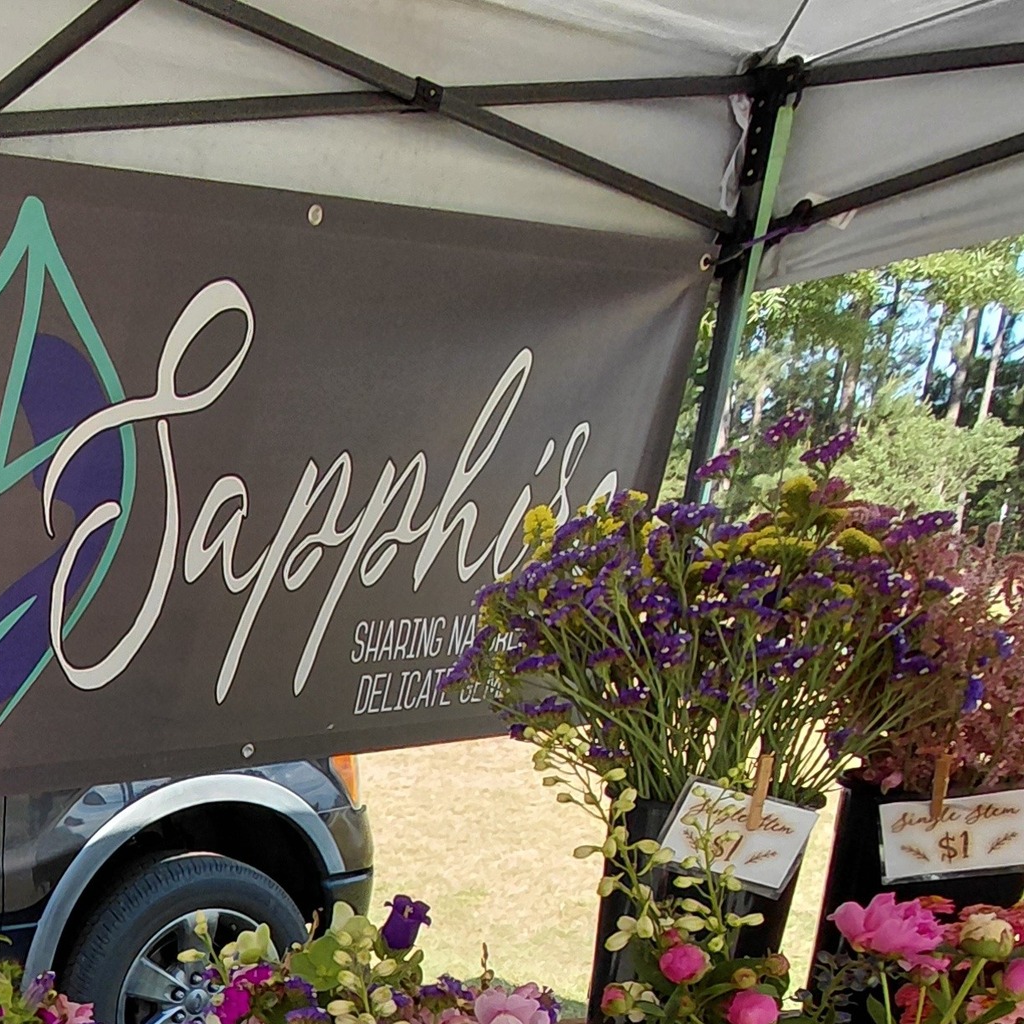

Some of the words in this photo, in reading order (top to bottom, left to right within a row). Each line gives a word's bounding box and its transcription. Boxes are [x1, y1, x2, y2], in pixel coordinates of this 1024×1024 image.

[350, 616, 446, 664] SHARING
[686, 797, 749, 826] Sngle
[891, 804, 962, 834] Single
[964, 802, 1020, 826] Stem
[711, 829, 744, 862] $1
[937, 830, 970, 863] $1
